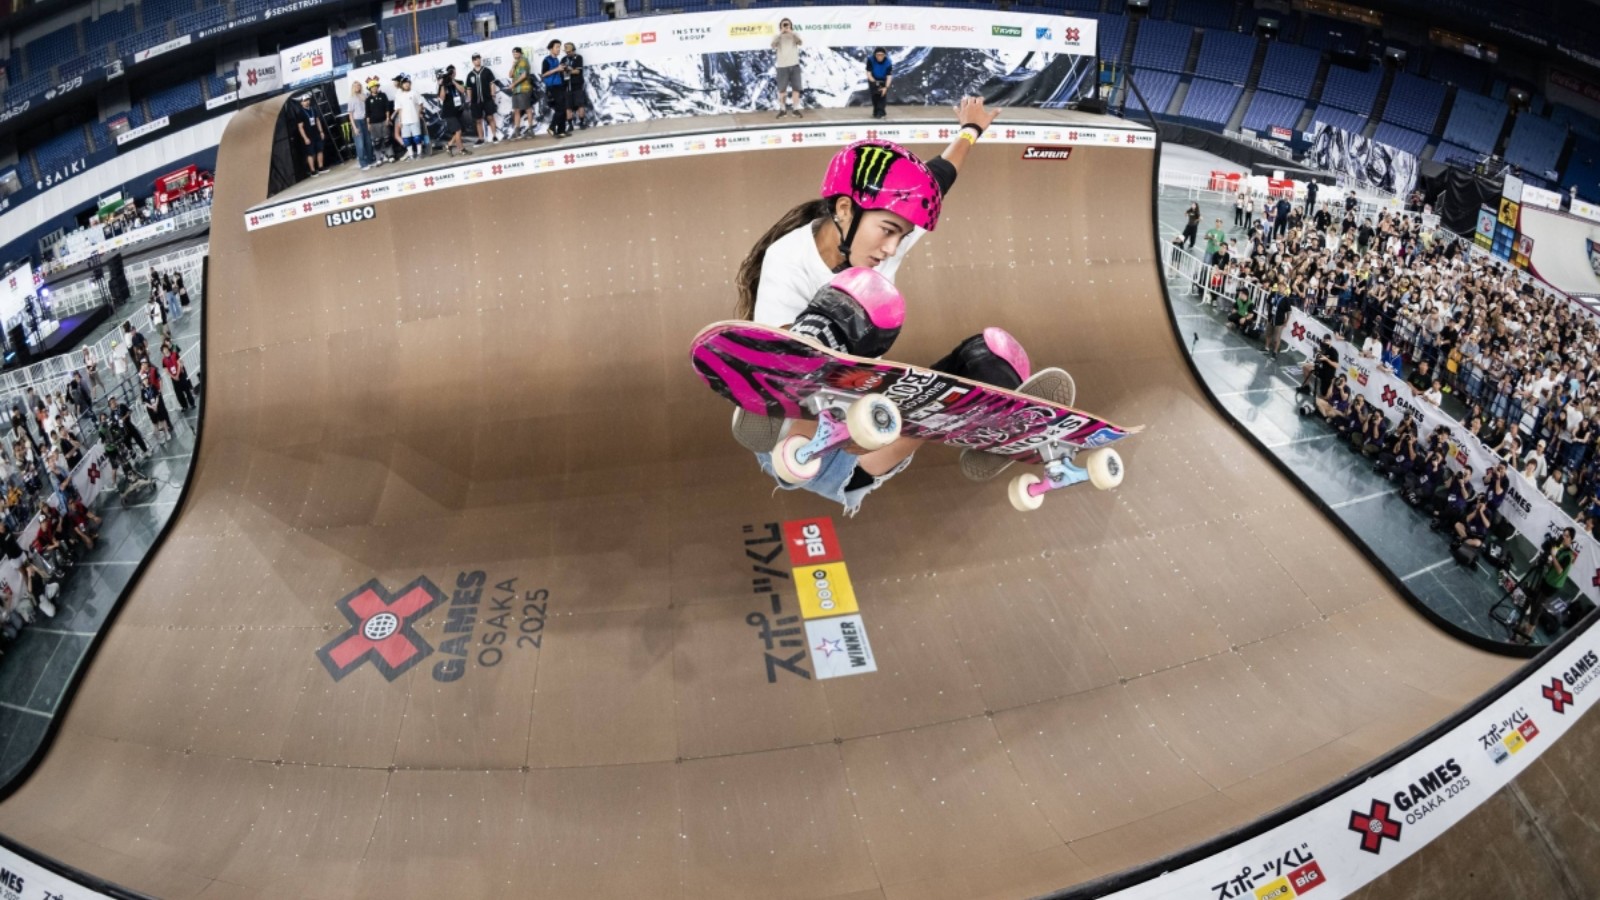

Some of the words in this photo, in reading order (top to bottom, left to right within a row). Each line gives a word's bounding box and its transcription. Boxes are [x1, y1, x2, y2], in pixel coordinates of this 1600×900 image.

[672, 26, 712, 35] INSTYLE
[45, 158, 87, 186] SAIKI
[1023, 147, 1069, 160] SKATELITE
[327, 206, 374, 227] ISUCO
[1396, 397, 1425, 423] GAMES
[1508, 487, 1533, 513] AMES
[477, 577, 518, 668] OSAKA
[516, 588, 549, 649] 2025
[742, 522, 812, 683] スポーツくじ
[431, 569, 488, 683] GAMES
[840, 621, 867, 668] WINNER
[1563, 650, 1599, 686] GAMES
[1478, 706, 1529, 751] スポーツくじ
[1393, 758, 1463, 812] GAMES
[1405, 796, 1446, 826] OSAKA
[1444, 777, 1471, 801] 2025
[0, 867, 25, 894] MES
[1211, 842, 1314, 900] スポーツくじ
[1295, 869, 1319, 888] BIG
